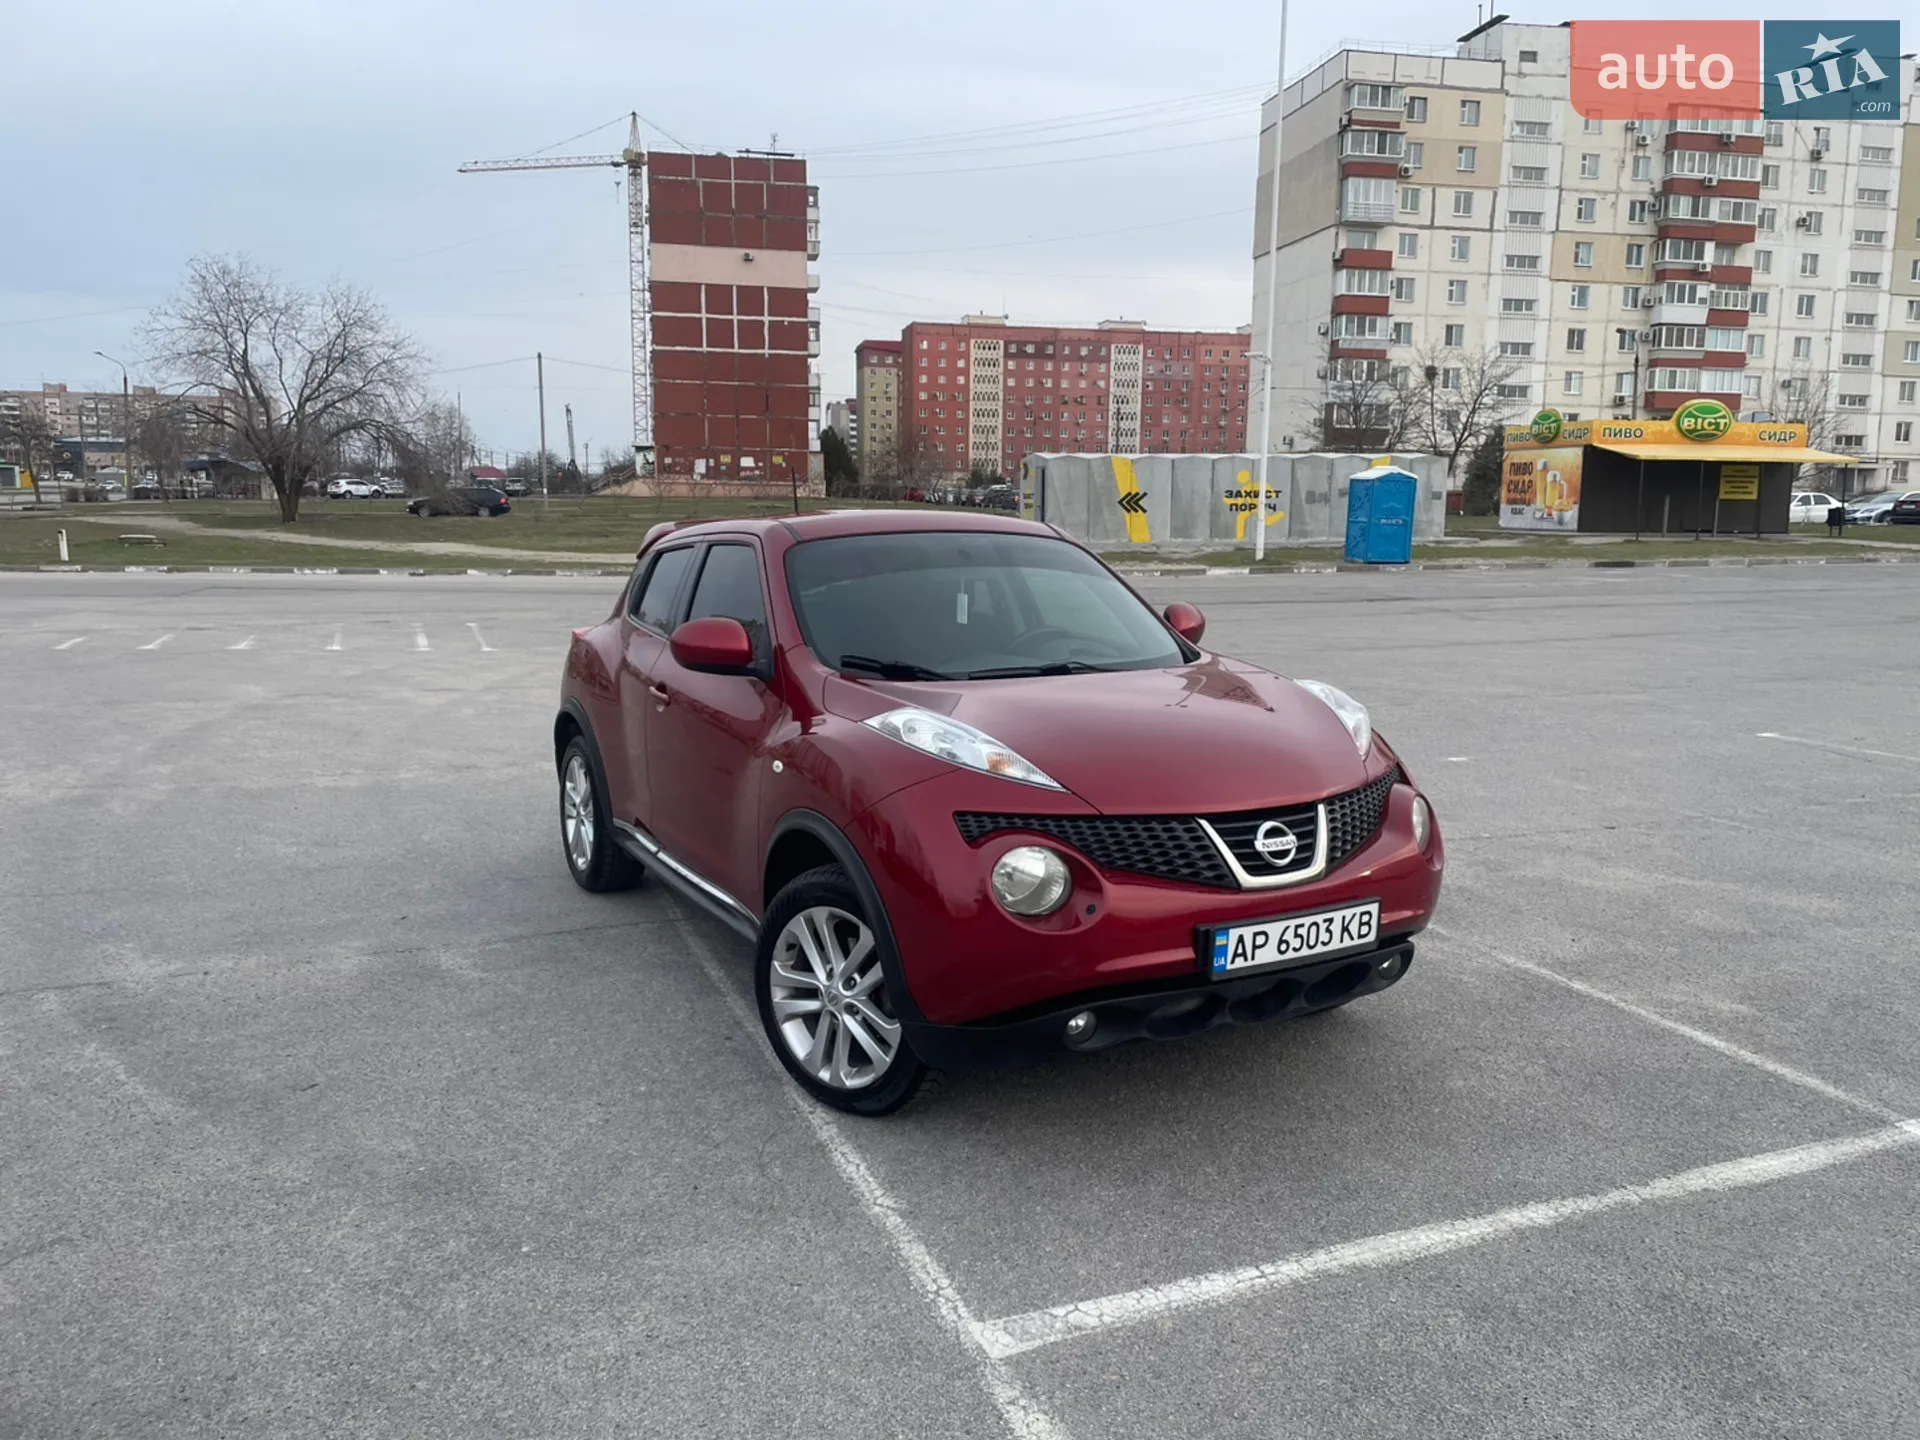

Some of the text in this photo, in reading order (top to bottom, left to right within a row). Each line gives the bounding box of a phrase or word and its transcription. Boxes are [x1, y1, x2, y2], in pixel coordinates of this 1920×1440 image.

[1562, 427, 1590, 440] СИДР
[1602, 427, 1644, 439] ПИВО
[1758, 430, 1797, 443] СИДР
[1509, 461, 1534, 477] ПИВО
[1507, 479, 1533, 495] СИДР
[1229, 502, 1277, 512] ПОРЧ
[1261, 838, 1296, 850] NISSAN
[1230, 910, 1373, 965] AP 6503 KB
[1213, 956, 1226, 967] UA
